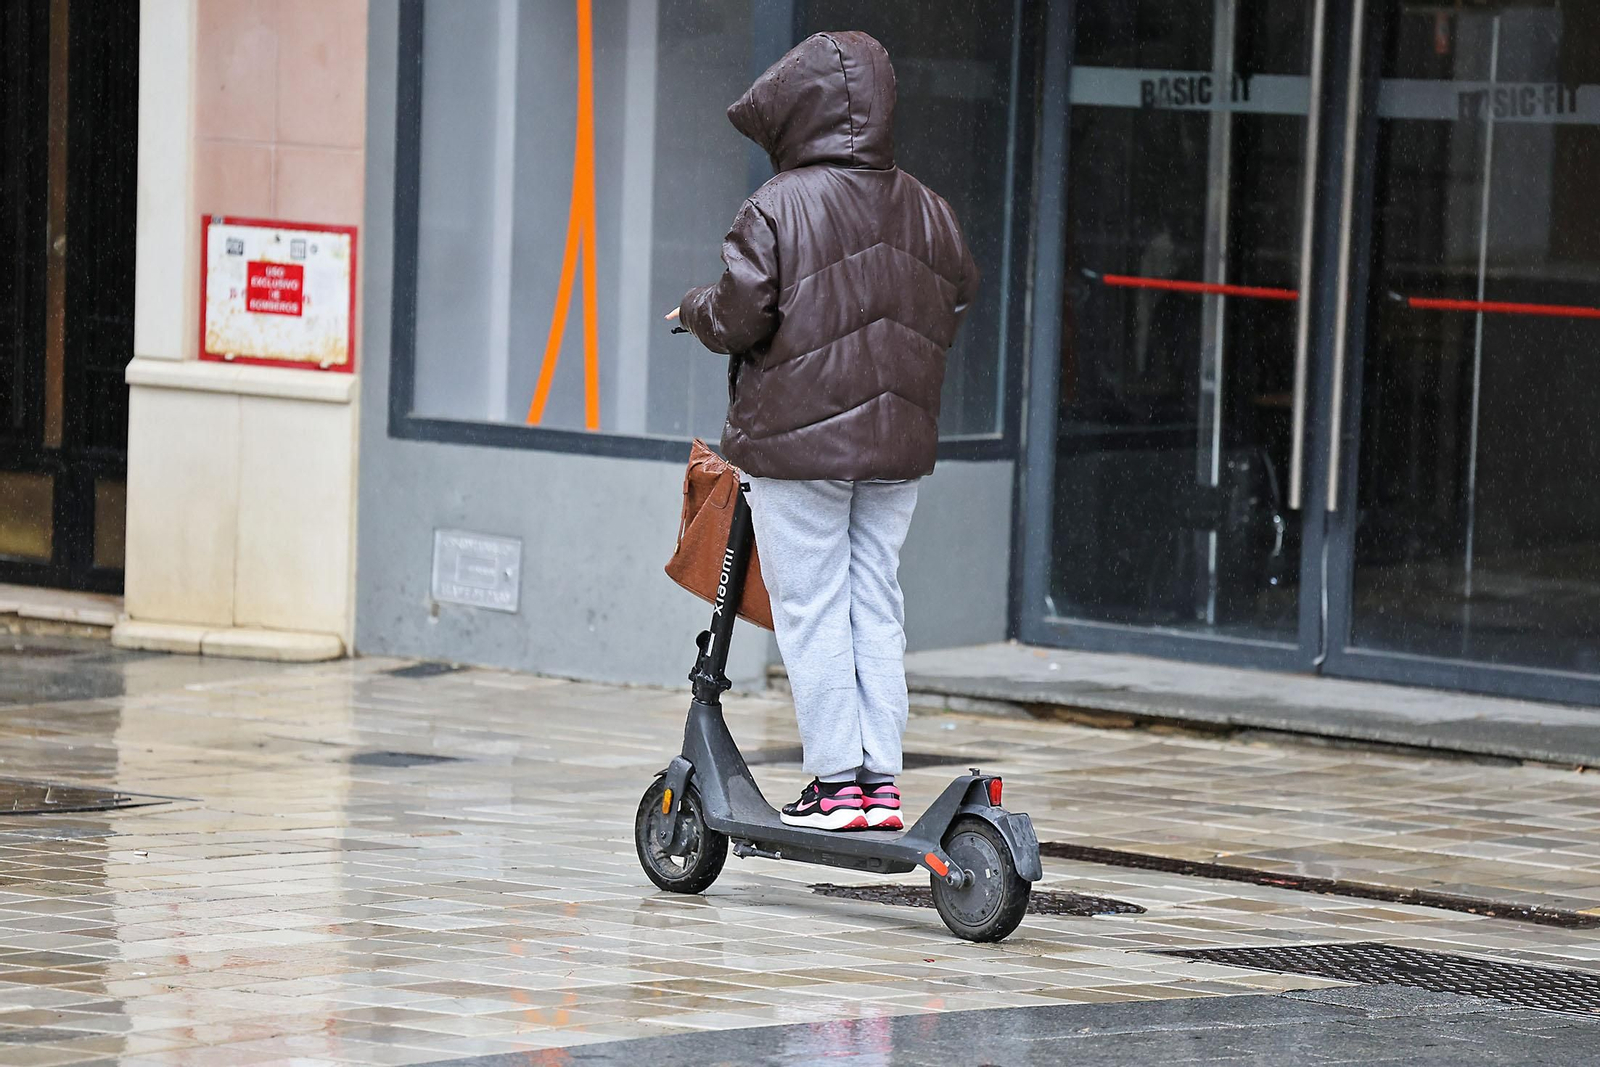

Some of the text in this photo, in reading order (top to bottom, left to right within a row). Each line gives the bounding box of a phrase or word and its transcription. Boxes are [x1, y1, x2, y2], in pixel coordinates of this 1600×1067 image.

[1141, 72, 1253, 108] BASICIT
[265, 266, 285, 278] USO
[251, 276, 298, 290] EXCLUSIVO
[249, 299, 299, 313] BOMBEROS
[714, 548, 735, 616] xiaomi
